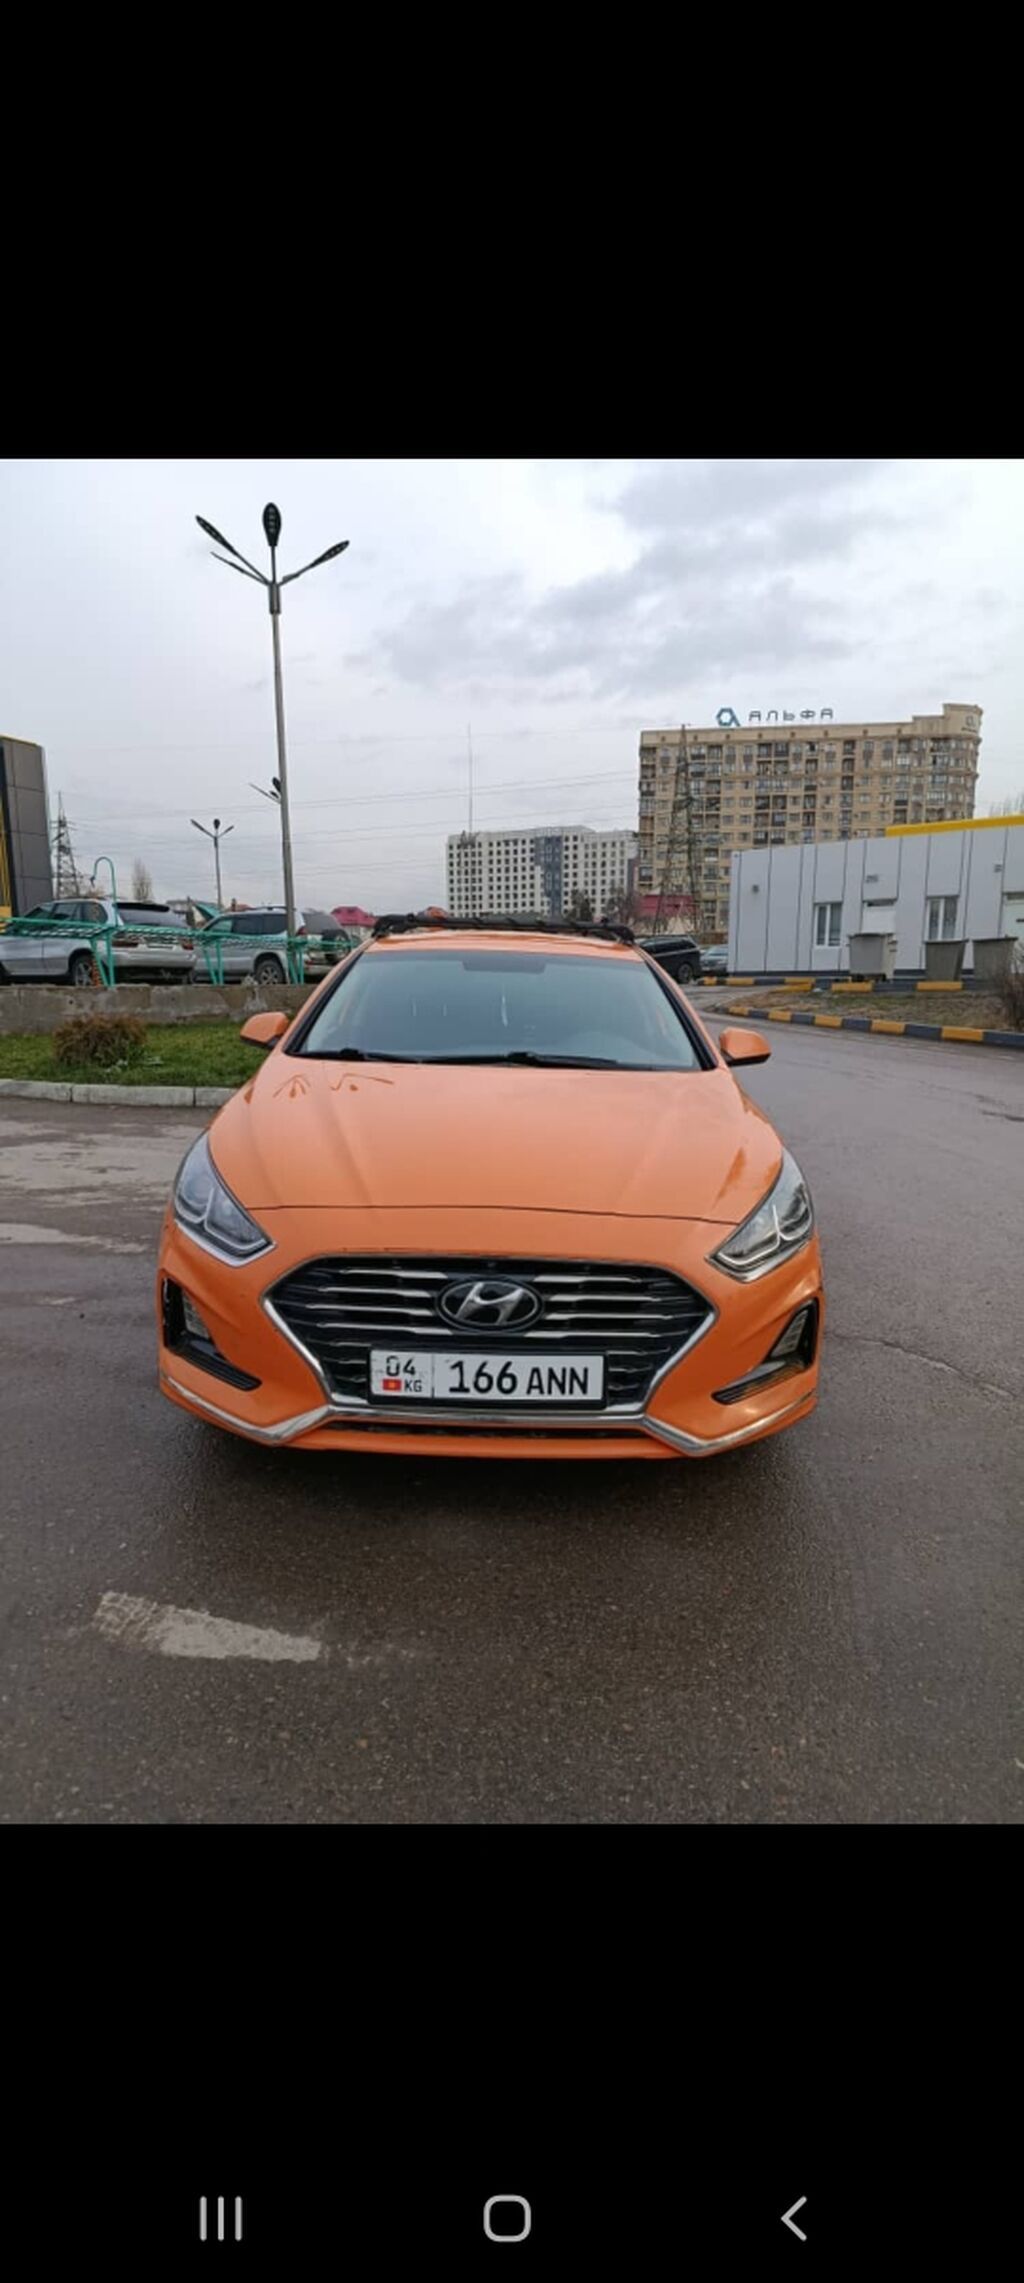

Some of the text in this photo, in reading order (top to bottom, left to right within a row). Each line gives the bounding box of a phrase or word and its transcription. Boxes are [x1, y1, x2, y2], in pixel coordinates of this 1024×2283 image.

[749, 709, 834, 722] АЛЬФА
[386, 1355, 416, 1377] 04
[404, 1379, 423, 1393] KG
[448, 1360, 589, 1396] 166 ANN
